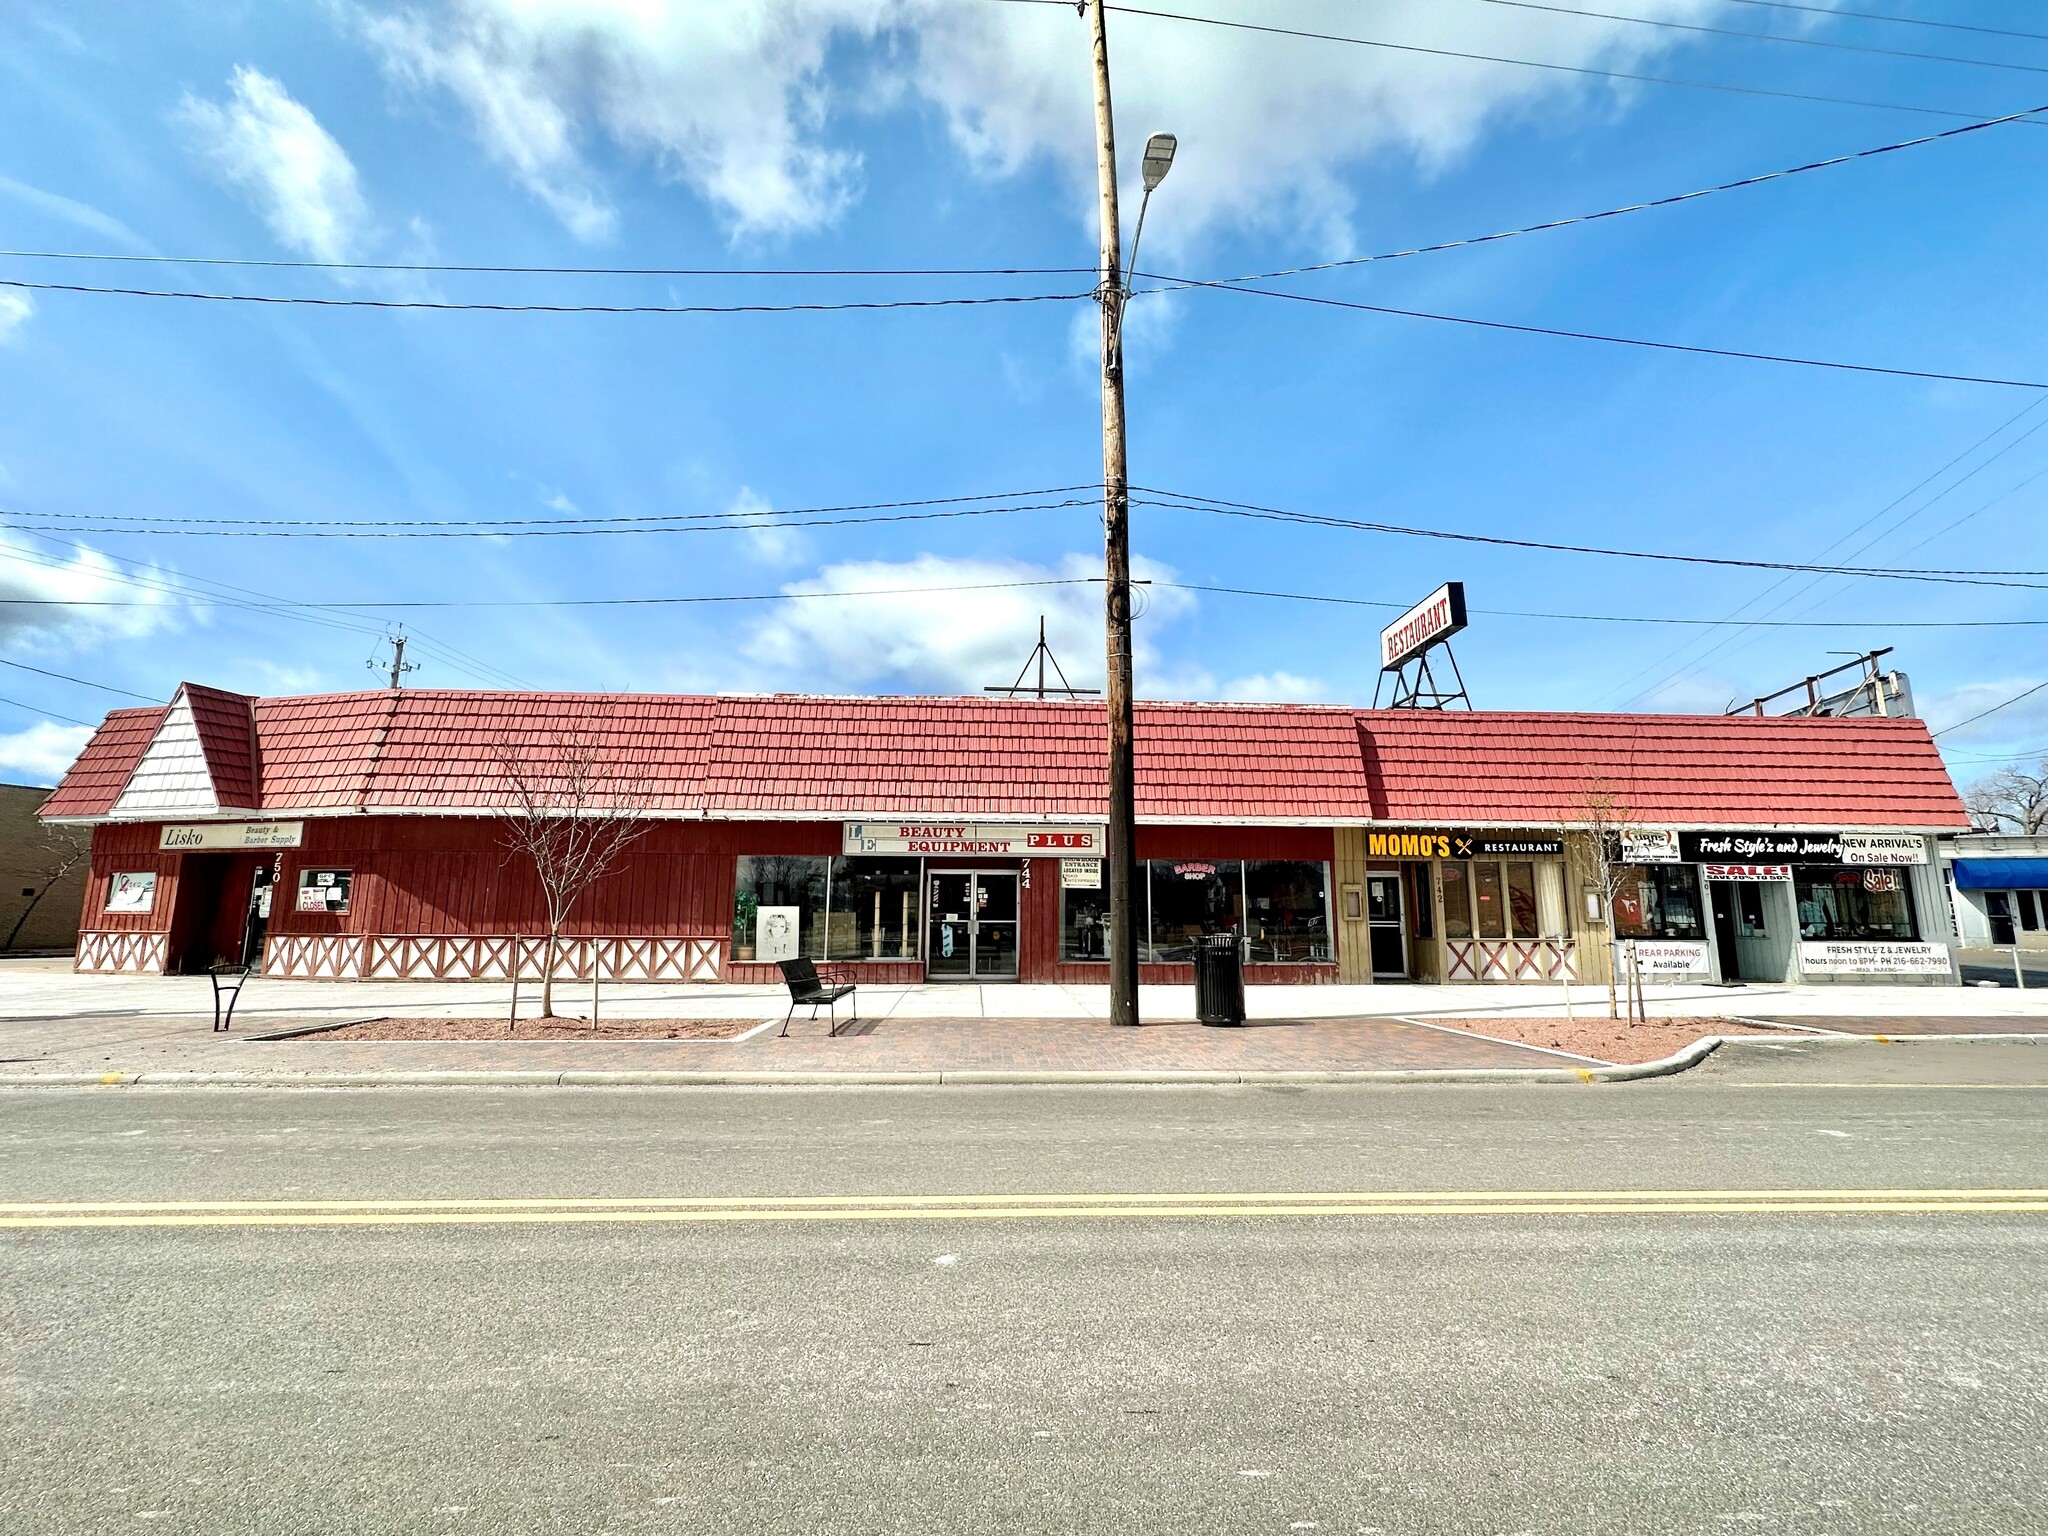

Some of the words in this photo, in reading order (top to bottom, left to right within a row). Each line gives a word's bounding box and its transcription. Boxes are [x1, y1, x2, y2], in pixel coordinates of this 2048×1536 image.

[1388, 597, 1447, 660] RESTAURANT
[246, 826, 270, 835] Beauty
[899, 827, 966, 838] BEAUTY
[165, 829, 203, 846] Lisko
[244, 836, 268, 844] Barber
[270, 836, 296, 844] Supply
[1029, 835, 1092, 846] PLUS
[908, 841, 1010, 853] EQUIPMENT
[1368, 834, 1450, 857] MOMO'S
[1485, 843, 1558, 852] RESTAURANT
[1700, 837, 1732, 853] Fresh
[1734, 837, 1774, 858] Style'z
[1777, 838, 1798, 853] and
[1800, 838, 1844, 858] Jewelry
[1842, 839, 1867, 848] NEW
[1870, 839, 1922, 848] ARRIVAL'S
[1850, 853, 1865, 862] On
[1868, 853, 1888, 862] Sale
[1891, 853, 1919, 862] Now!!
[272, 853, 284, 882] 750
[1022, 858, 1031, 888] 744
[1174, 863, 1216, 875] BARBER
[1706, 866, 1788, 875] SALE!
[1864, 868, 1900, 892] Sale!
[1639, 949, 1662, 957] REAR
[1664, 949, 1701, 957] PARKING
[1827, 946, 1853, 954] FRESH
[1887, 946, 1892, 954] &
[1894, 946, 1932, 954] JEWELRY
[1653, 960, 1690, 969] Available
[1805, 957, 1827, 965] hours
